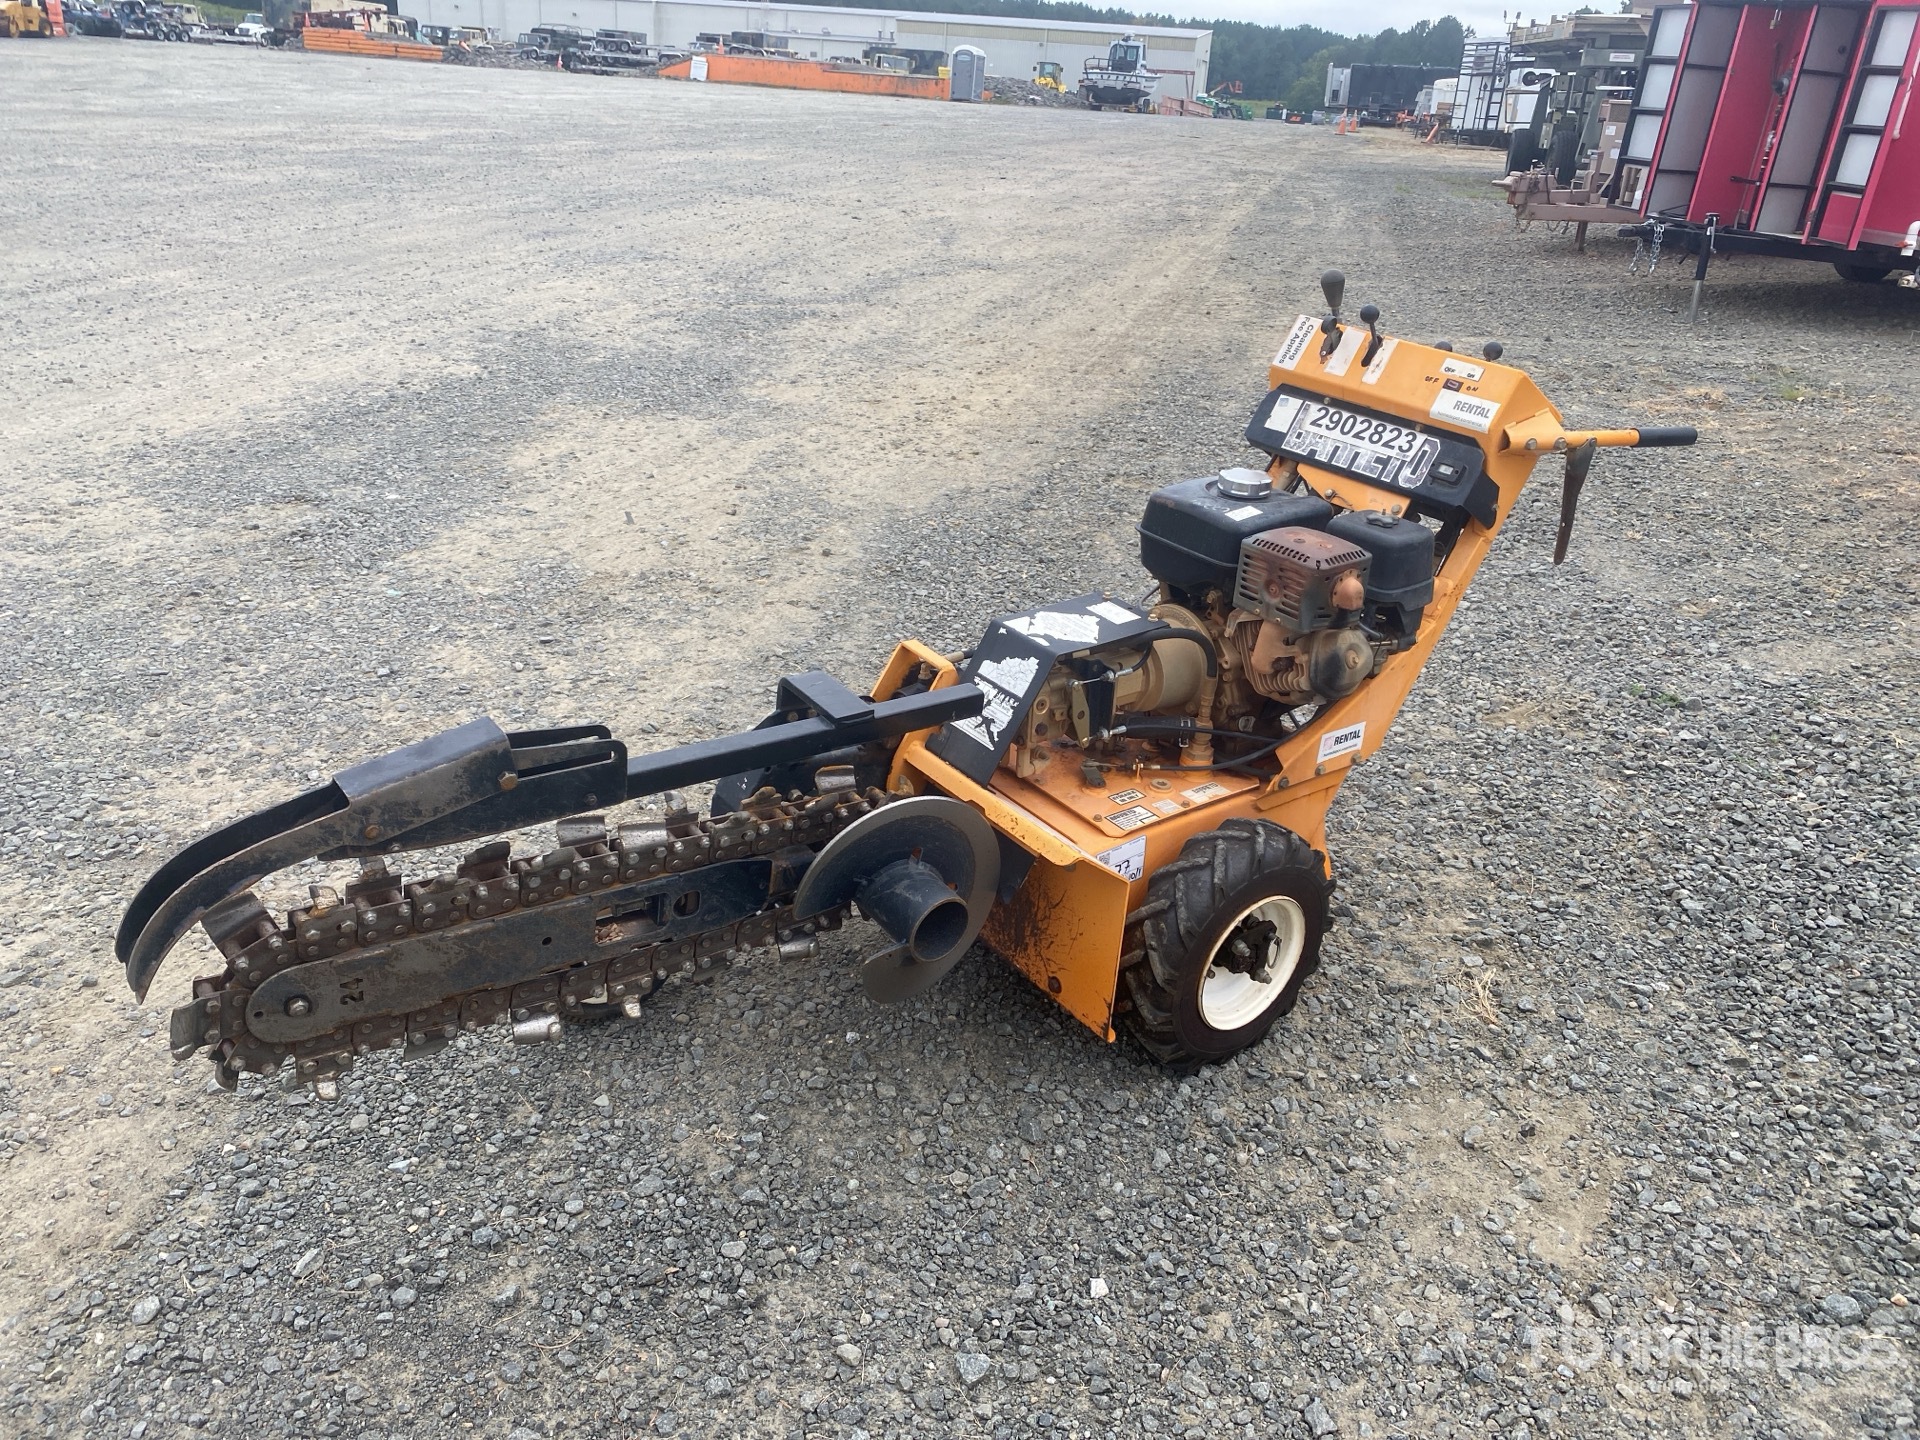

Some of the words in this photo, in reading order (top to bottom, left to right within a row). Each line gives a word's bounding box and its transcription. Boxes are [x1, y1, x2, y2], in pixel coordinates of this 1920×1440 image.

[1298, 316, 1311, 331] Fee
[1279, 333, 1300, 364] Applies
[1289, 324, 1314, 361] Cleaning
[1452, 400, 1491, 419] RENTAL
[1309, 406, 1418, 454] 2902823
[1333, 729, 1361, 746] RENTAL
